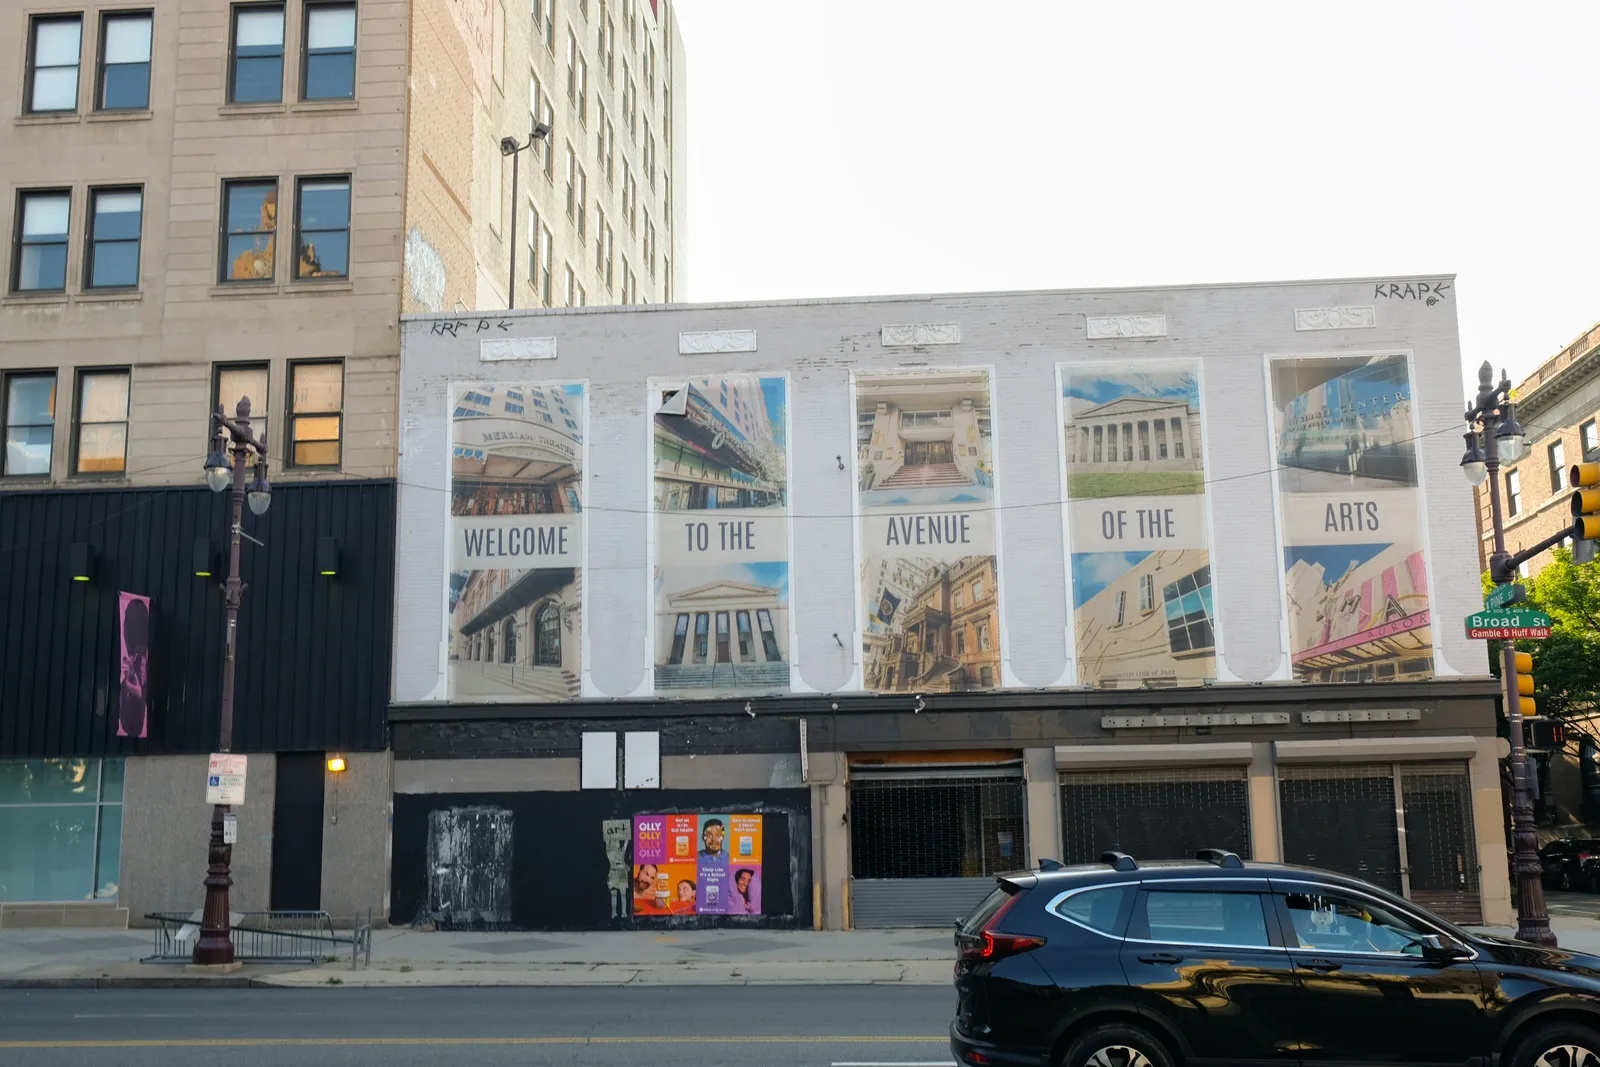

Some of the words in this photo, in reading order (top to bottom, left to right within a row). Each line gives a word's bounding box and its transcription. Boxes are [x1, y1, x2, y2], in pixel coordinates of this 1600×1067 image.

[1374, 282, 1430, 300] KRAP
[1340, 391, 1405, 414] CENTER
[482, 431, 533, 442] MERRIAM
[1324, 501, 1380, 532] ARTS
[886, 514, 971, 546] AVENUE
[1101, 510, 1127, 540] OF
[1136, 508, 1175, 539] THE
[463, 526, 568, 557] WELCOME
[685, 522, 709, 552] TO
[718, 521, 755, 551] THE
[1490, 592, 1504, 608] PINE
[1507, 590, 1514, 600] ST
[1505, 607, 1511, 615] S
[1472, 615, 1520, 627] Broad
[1533, 617, 1546, 627] St
[1471, 629, 1501, 638] Gamble
[1503, 629, 1509, 637] &
[1511, 628, 1528, 637] Huff
[1530, 628, 1549, 637] Walk
[606, 823, 628, 835] art
[639, 822, 661, 831] OLLY
[639, 831, 661, 840] OLLY
[639, 840, 661, 848] OLLY
[639, 849, 661, 858] OLLY
